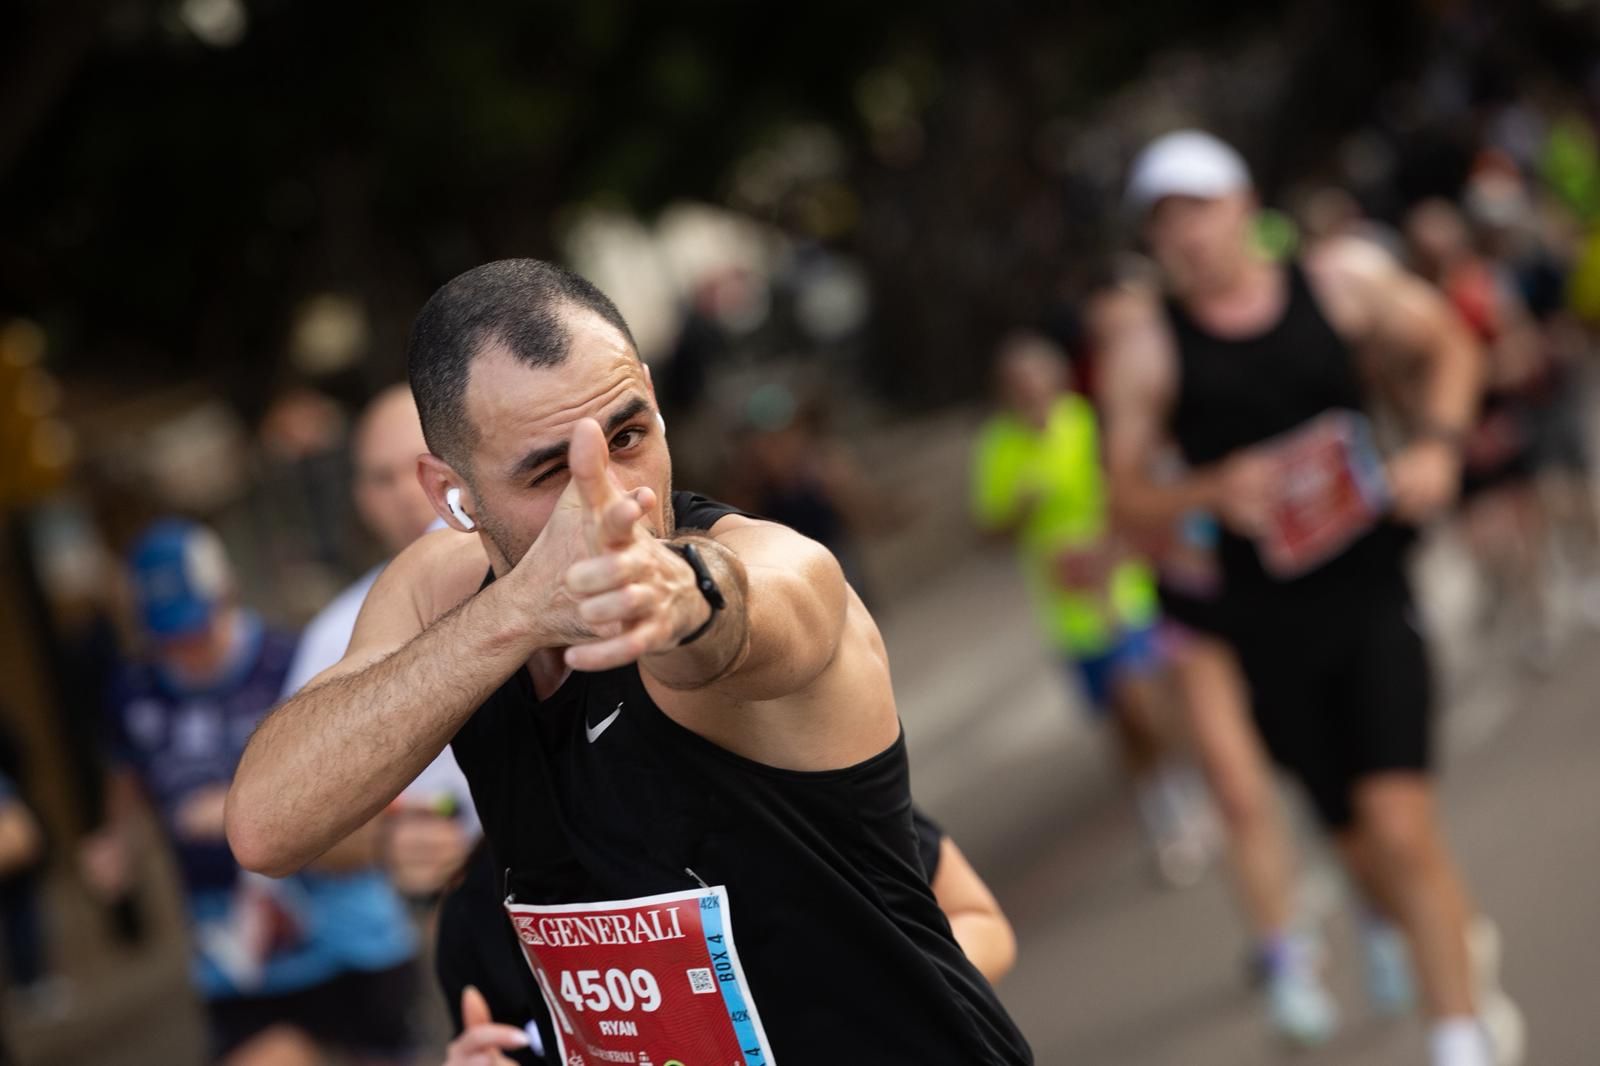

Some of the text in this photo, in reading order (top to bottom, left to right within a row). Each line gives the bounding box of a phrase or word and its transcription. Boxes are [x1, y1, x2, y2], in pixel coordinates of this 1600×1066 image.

[700, 896, 720, 910] 42K
[539, 907, 686, 947] GENERALI
[707, 933, 735, 982] BOX 4
[560, 968, 661, 1012] 4509
[731, 1009, 751, 1022] 42K
[599, 1021, 638, 1036] RYAN
[744, 1047, 760, 1056] 4
